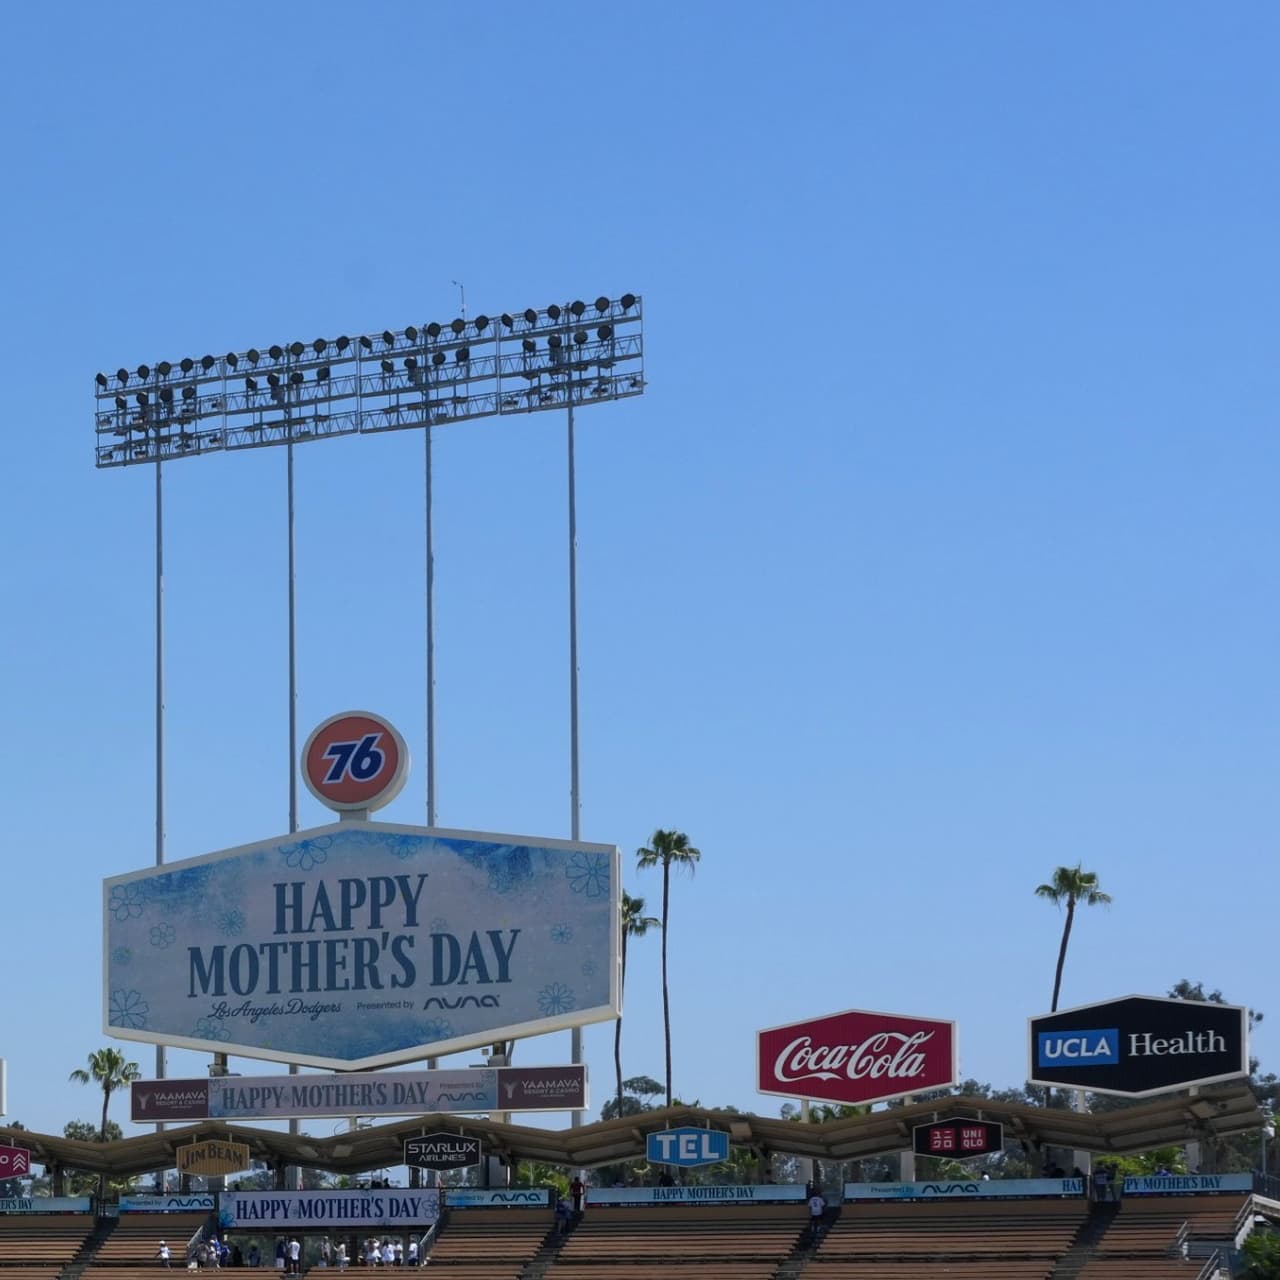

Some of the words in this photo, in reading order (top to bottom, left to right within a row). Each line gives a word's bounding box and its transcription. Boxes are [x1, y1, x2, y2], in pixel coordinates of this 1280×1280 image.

[321, 733, 386, 785] 76
[273, 873, 430, 936] HAPPY
[186, 930, 417, 998] MOTHER'S
[429, 928, 522, 987] DAY
[207, 1001, 234, 1020] Los
[230, 999, 285, 1025] Angeles
[286, 997, 343, 1022] Dodgers
[356, 1001, 401, 1012] Presented
[403, 1000, 415, 1012] by
[1044, 1038, 1112, 1060] UCLA
[1127, 1029, 1227, 1058] Health
[773, 1028, 936, 1083] Coca-Cola
[222, 1085, 286, 1111] HAPPY
[289, 1080, 390, 1109] MOTHER'S
[392, 1079, 431, 1106] DAY
[962, 1129, 983, 1139] UNI
[962, 1138, 985, 1148] QLO
[407, 1142, 477, 1154] STARLUX
[418, 1153, 467, 1162] AIRLINES
[655, 1134, 720, 1160] TEL
[652, 1187, 686, 1201] HAPPY
[687, 1185, 735, 1200] MOTHER'S
[736, 1185, 756, 1198] DAY
[1142, 1177, 1199, 1190] MOTHER'S
[1200, 1175, 1223, 1188] DAY
[235, 1198, 295, 1220] HAPPY
[299, 1197, 385, 1220] MOTHER'S
[386, 1197, 422, 1218] DAY
